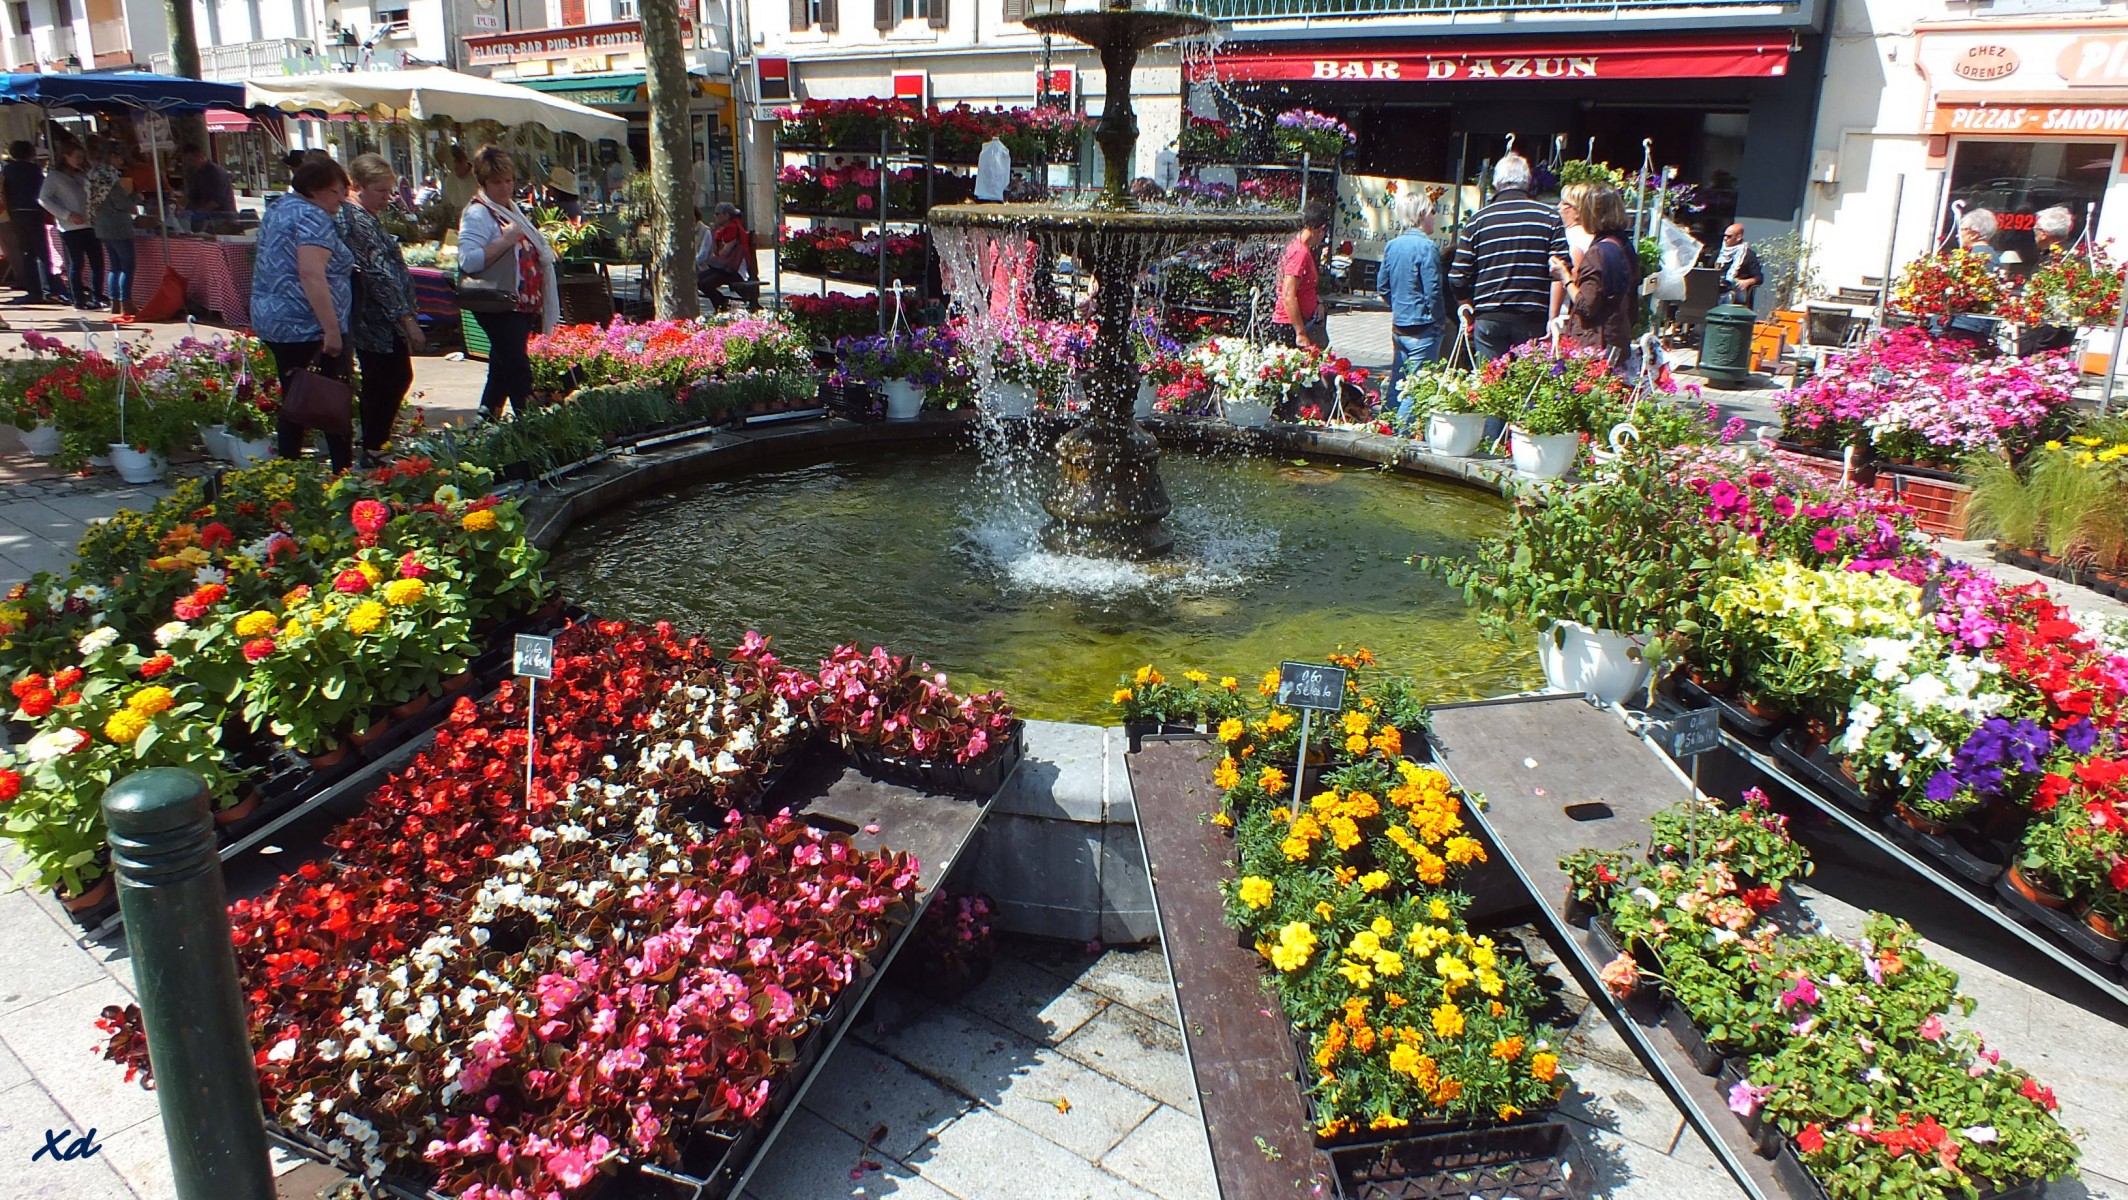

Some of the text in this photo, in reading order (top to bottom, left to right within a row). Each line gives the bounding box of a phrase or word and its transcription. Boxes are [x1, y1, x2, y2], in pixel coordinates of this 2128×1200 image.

[477, 16, 497, 27] PUB
[593, 31, 638, 48] CENTRE
[1969, 45, 2006, 58] CHEZ
[1311, 57, 1599, 80] BAR D'AZUN
[1955, 62, 2014, 78] LORENZO
[1951, 108, 2027, 129] PIZZAS
